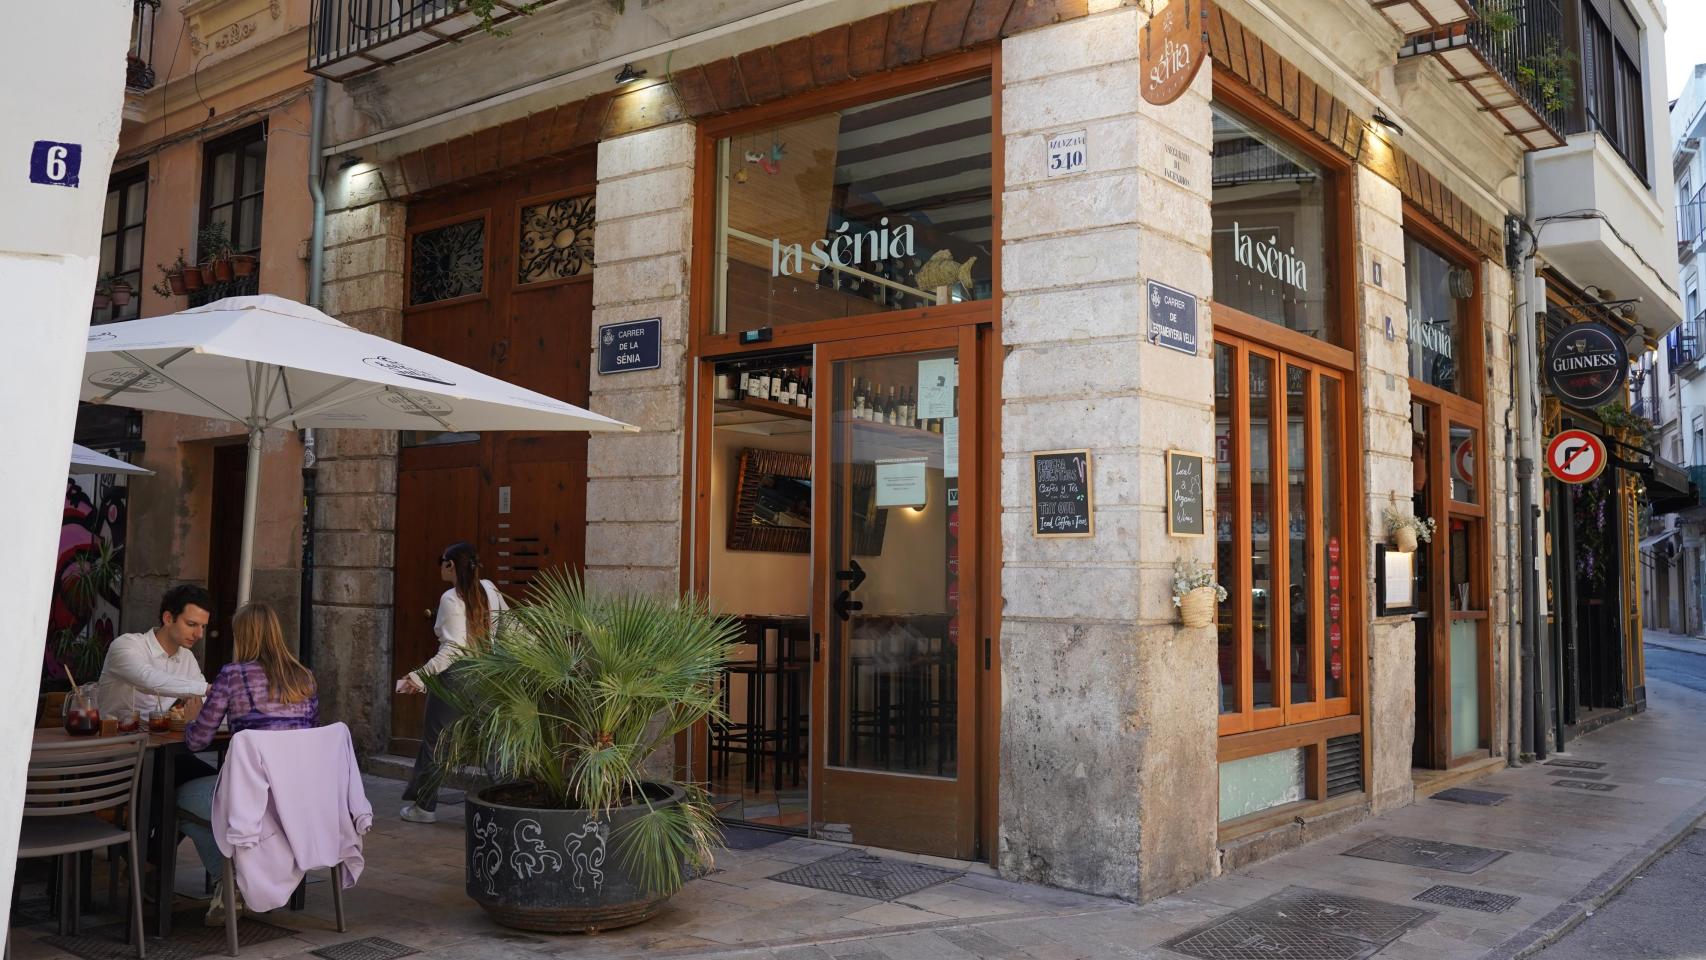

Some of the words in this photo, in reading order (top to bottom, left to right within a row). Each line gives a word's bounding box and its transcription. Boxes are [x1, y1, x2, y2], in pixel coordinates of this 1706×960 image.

[46, 145, 68, 181] 6
[772, 237, 804, 278] la
[810, 216, 917, 271] sénia
[1233, 221, 1254, 269] la
[1256, 234, 1308, 292] sénia
[1163, 295, 1186, 310] CARRER
[1169, 312, 1178, 322] DE
[618, 328, 645, 339] CARRER
[1421, 316, 1452, 359] sénia
[619, 342, 628, 350] DE
[629, 341, 639, 349] LA
[616, 352, 641, 365] SÉNIA
[1553, 354, 1617, 372] GUINNESS
